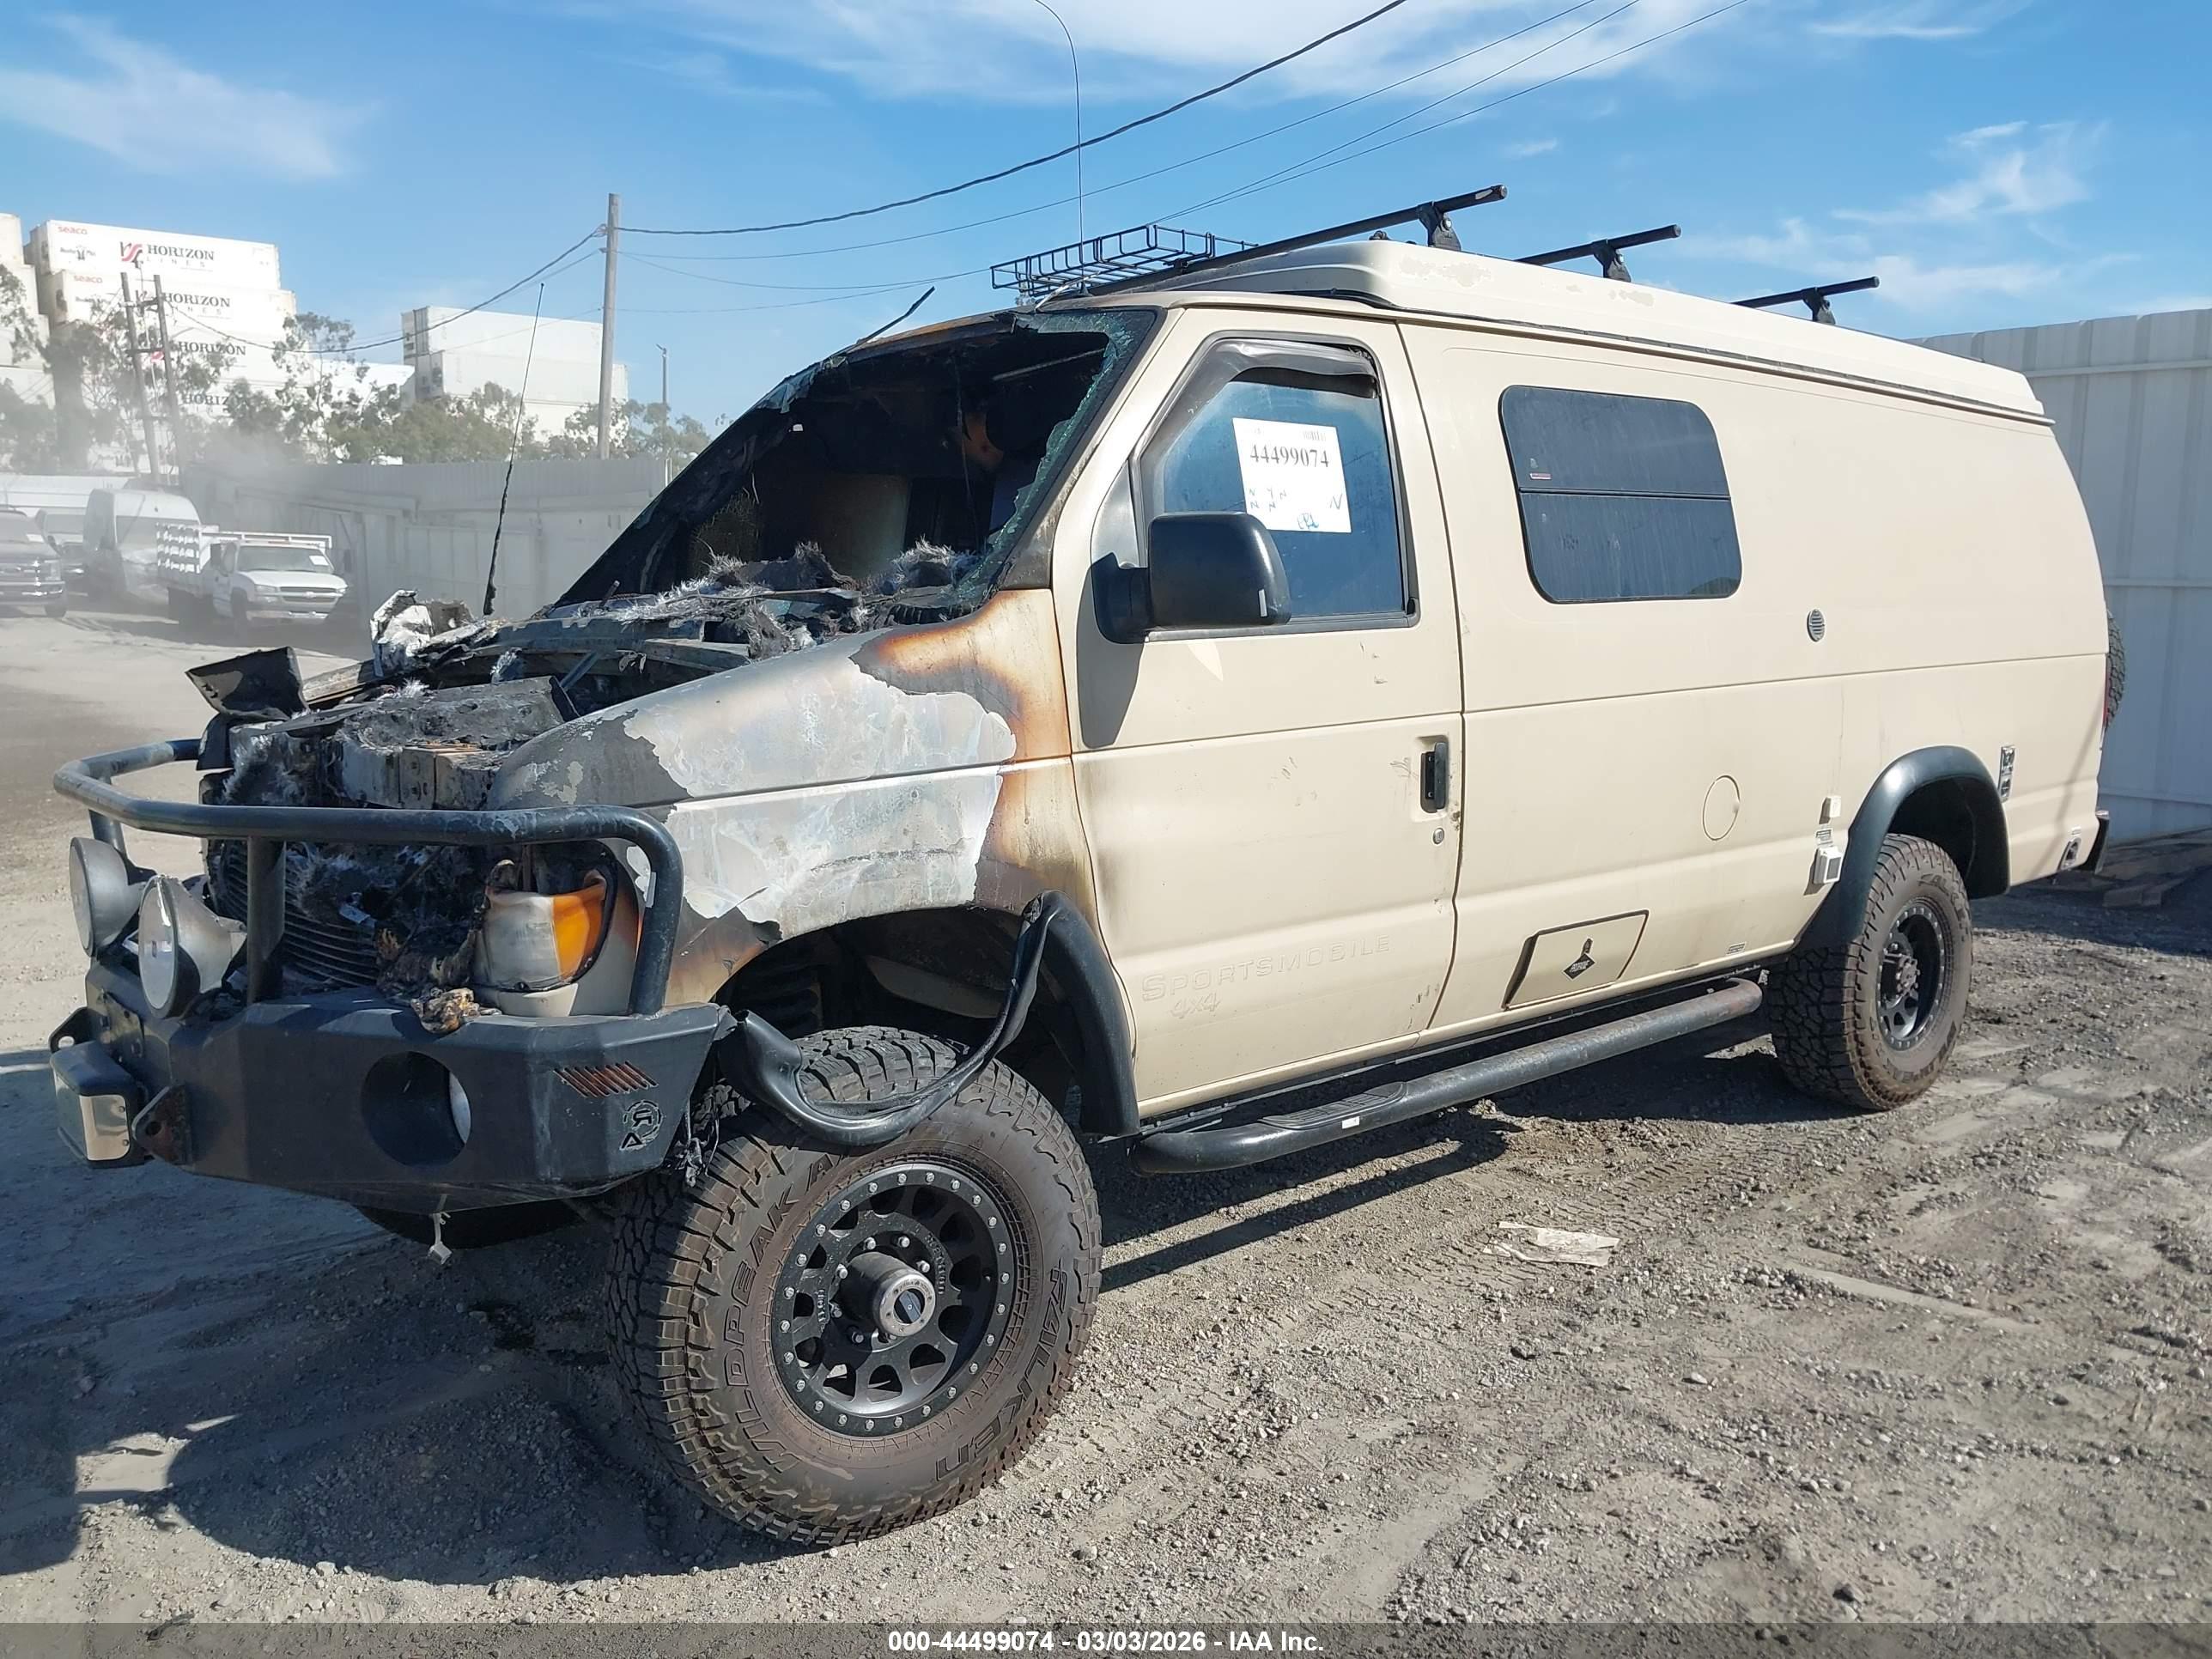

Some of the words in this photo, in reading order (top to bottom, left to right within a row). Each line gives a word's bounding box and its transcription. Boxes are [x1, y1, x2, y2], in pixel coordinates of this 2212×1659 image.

[58, 226, 88, 235] seaco
[147, 243, 215, 261] HORIZON
[73, 275, 103, 284] seaco
[162, 292, 231, 307] HORIZON
[178, 341, 246, 356] HORIZON
[1250, 444, 1329, 467] 44499074
[1140, 934, 1390, 1002] SPORTSMOBILE
[723, 1182, 803, 1474] WILDPEAK
[935, 1257, 1068, 1482] FALKEN
